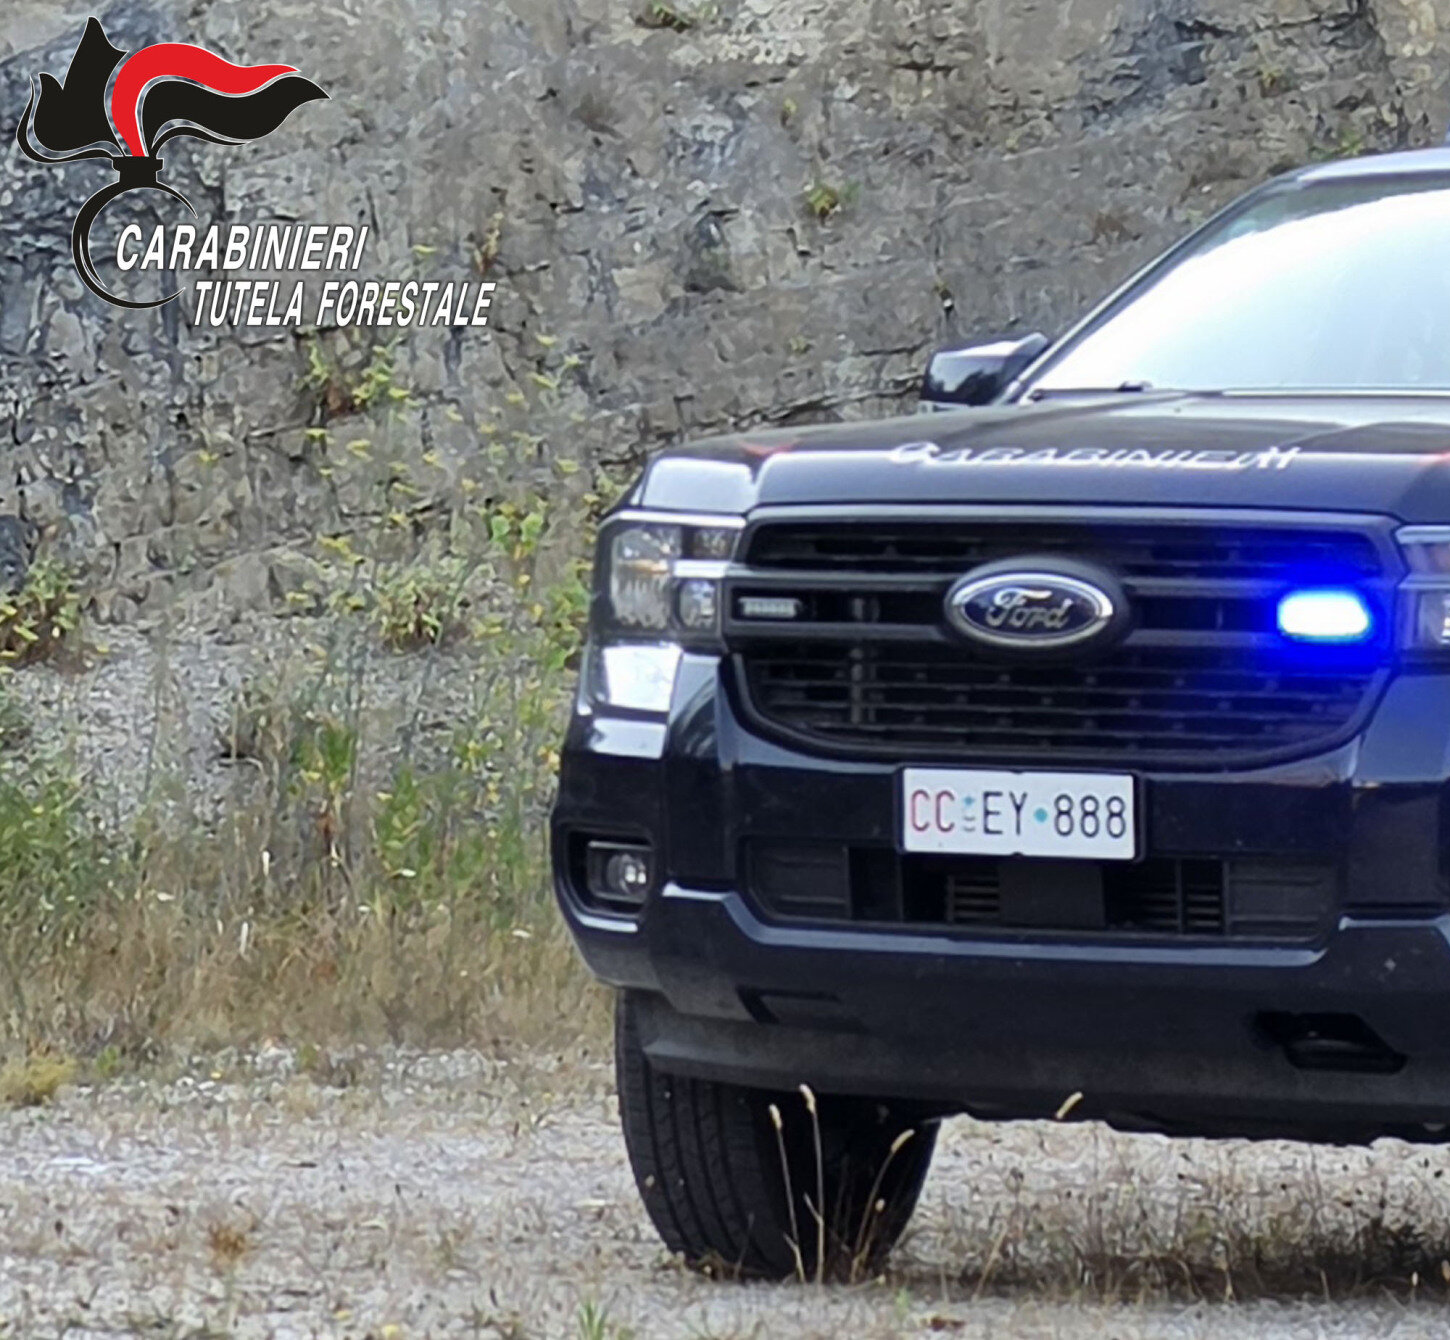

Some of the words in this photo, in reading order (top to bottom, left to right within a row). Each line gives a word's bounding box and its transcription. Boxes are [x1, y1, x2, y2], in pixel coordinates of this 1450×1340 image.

[985, 587, 1074, 629] Ford
[910, 789, 955, 833] CC
[983, 791, 1028, 836] EY
[1054, 793, 1126, 839] 888
